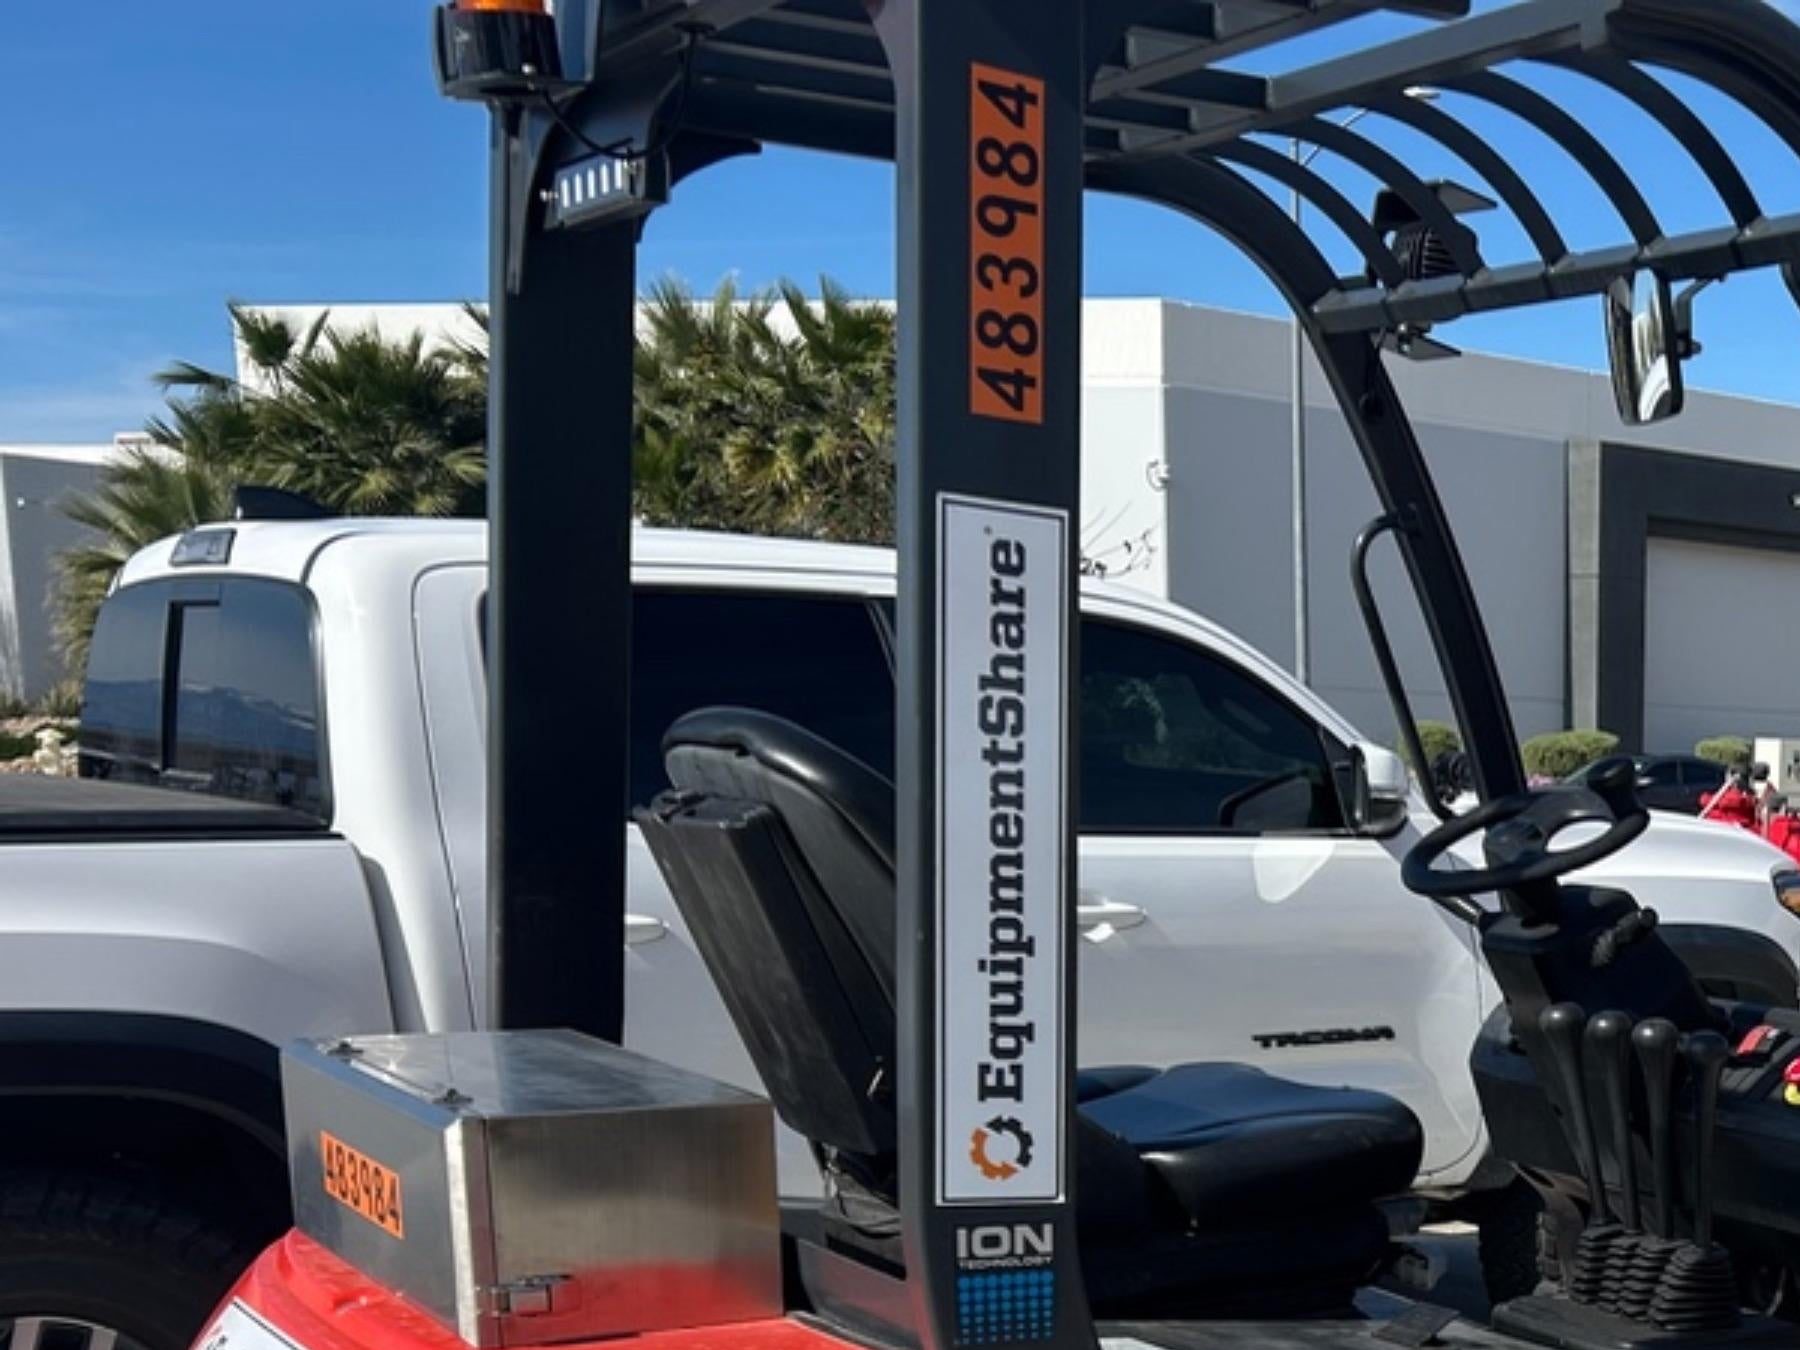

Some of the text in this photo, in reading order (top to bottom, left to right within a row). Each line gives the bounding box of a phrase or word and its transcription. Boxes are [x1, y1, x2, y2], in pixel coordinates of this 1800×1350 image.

[976, 79, 1038, 412] 483984
[977, 538, 1036, 1102] EquipmentShare
[326, 1139, 400, 1233] 483984
[956, 1223, 1053, 1258] ION
